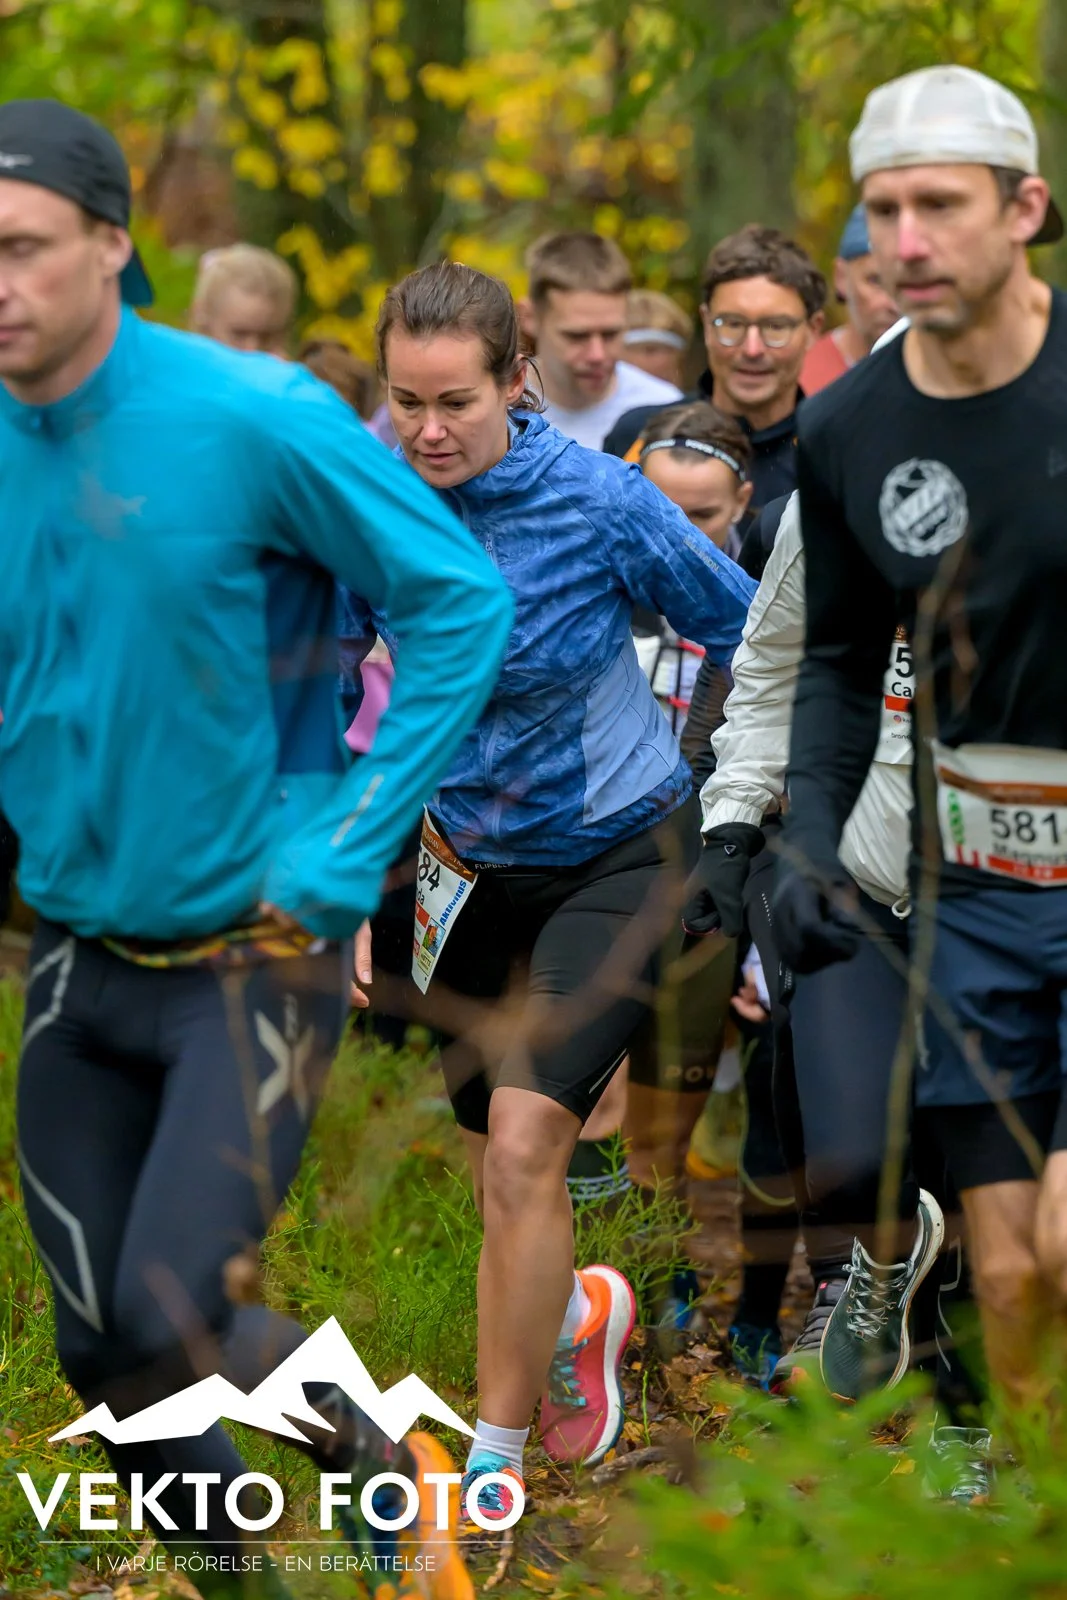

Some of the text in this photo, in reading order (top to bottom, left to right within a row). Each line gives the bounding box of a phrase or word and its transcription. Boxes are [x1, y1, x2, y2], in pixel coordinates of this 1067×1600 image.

[891, 681, 914, 698] Ca
[418, 850, 441, 892] 84
[416, 887, 425, 905] da
[439, 879, 467, 927] Aktivitus
